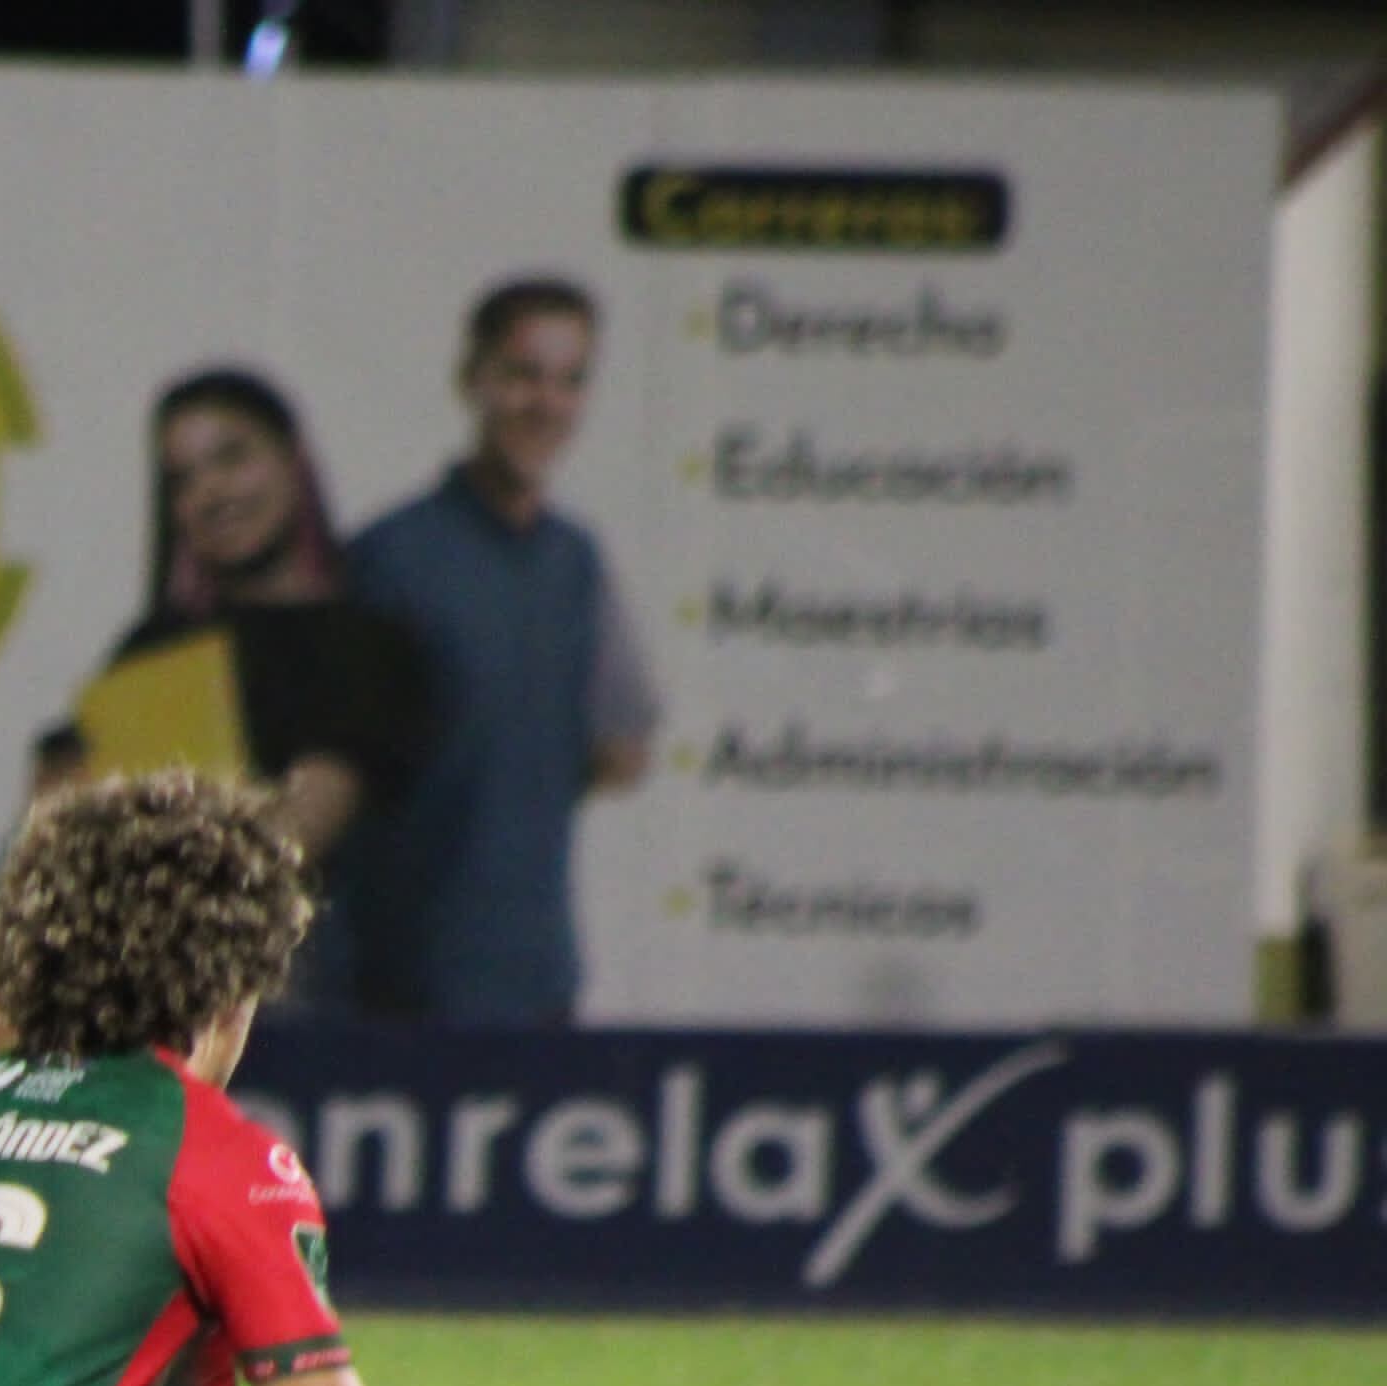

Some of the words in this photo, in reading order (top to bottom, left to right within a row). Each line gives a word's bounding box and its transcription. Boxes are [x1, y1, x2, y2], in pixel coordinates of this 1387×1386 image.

[717, 274, 1007, 358] Derecho
[711, 422, 1075, 504] Educación
[1057, 1068, 1387, 1266] plu
